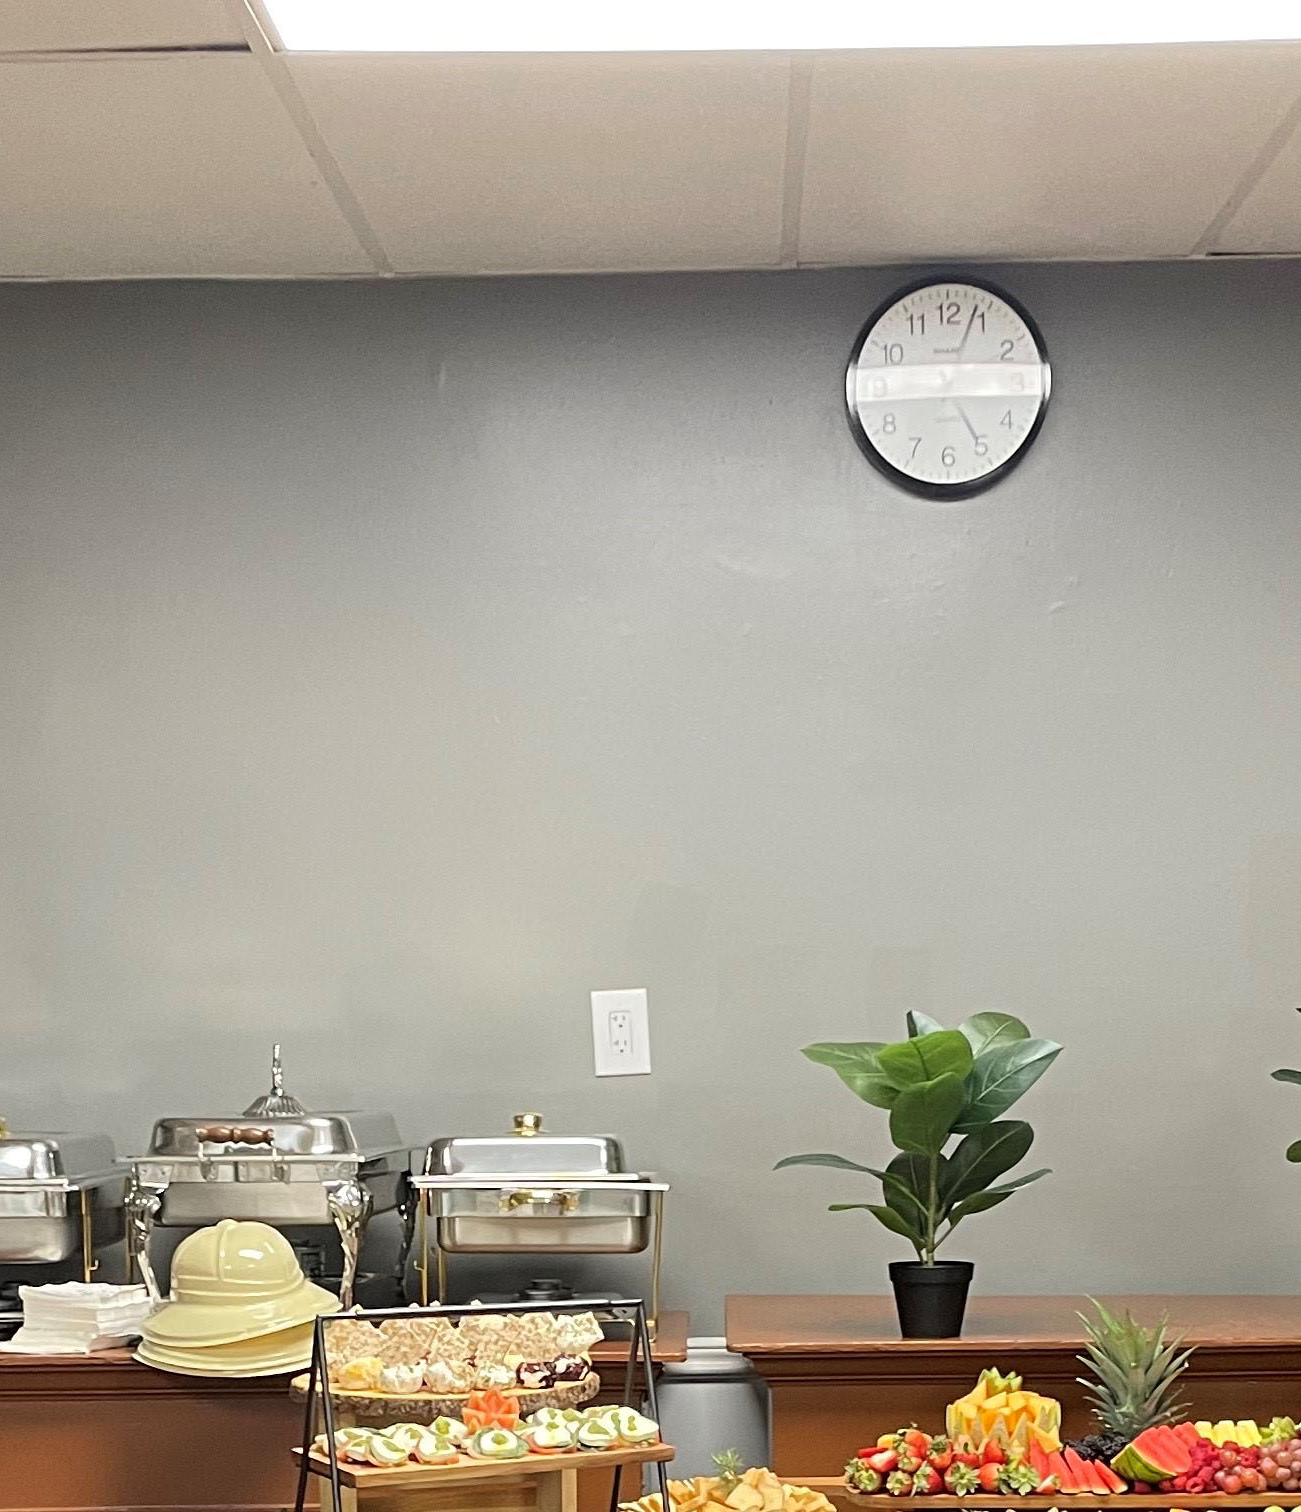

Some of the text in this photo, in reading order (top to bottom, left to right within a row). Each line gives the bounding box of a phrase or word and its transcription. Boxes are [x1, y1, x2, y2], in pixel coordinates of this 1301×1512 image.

[906, 313, 925, 335] 11
[937, 302, 961, 325] 12
[976, 311, 986, 334] 1
[882, 343, 904, 365] 10
[999, 339, 1015, 361] 2
[882, 413, 897, 434] 8
[999, 409, 1013, 430] 4
[908, 437, 922, 459] 7
[941, 445, 956, 467] 6
[973, 434, 989, 456] 5
